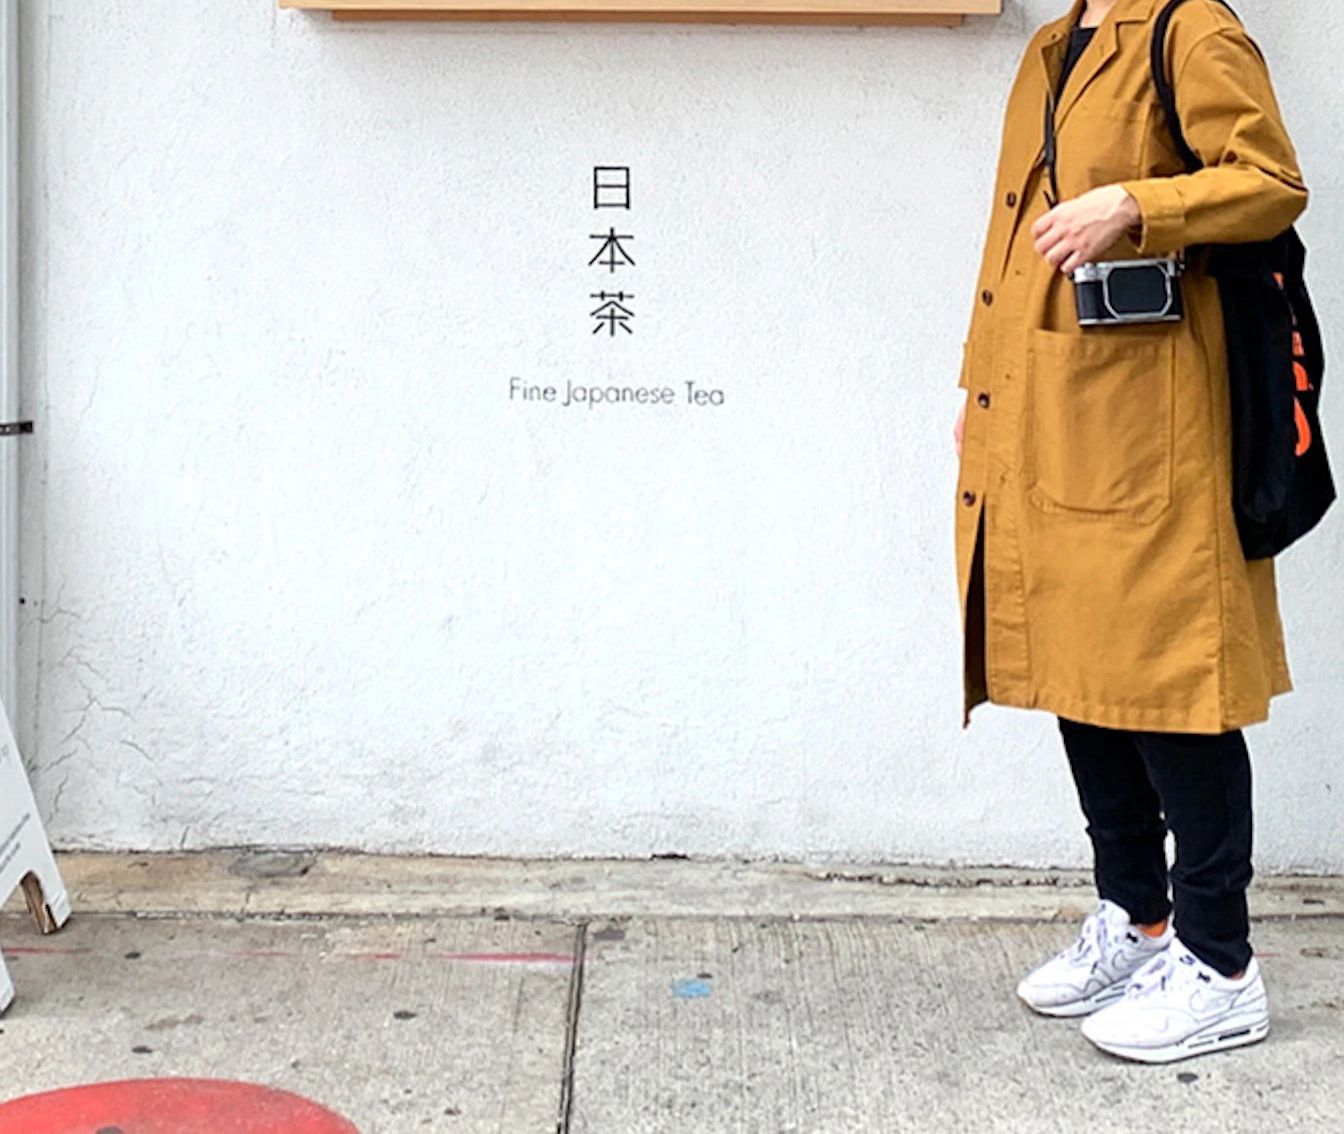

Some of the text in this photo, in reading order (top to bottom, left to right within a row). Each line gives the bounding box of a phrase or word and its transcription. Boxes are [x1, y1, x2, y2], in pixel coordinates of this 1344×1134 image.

[587, 165, 636, 337] 日本茶
[509, 376, 725, 410] Fine Japanese Tea
